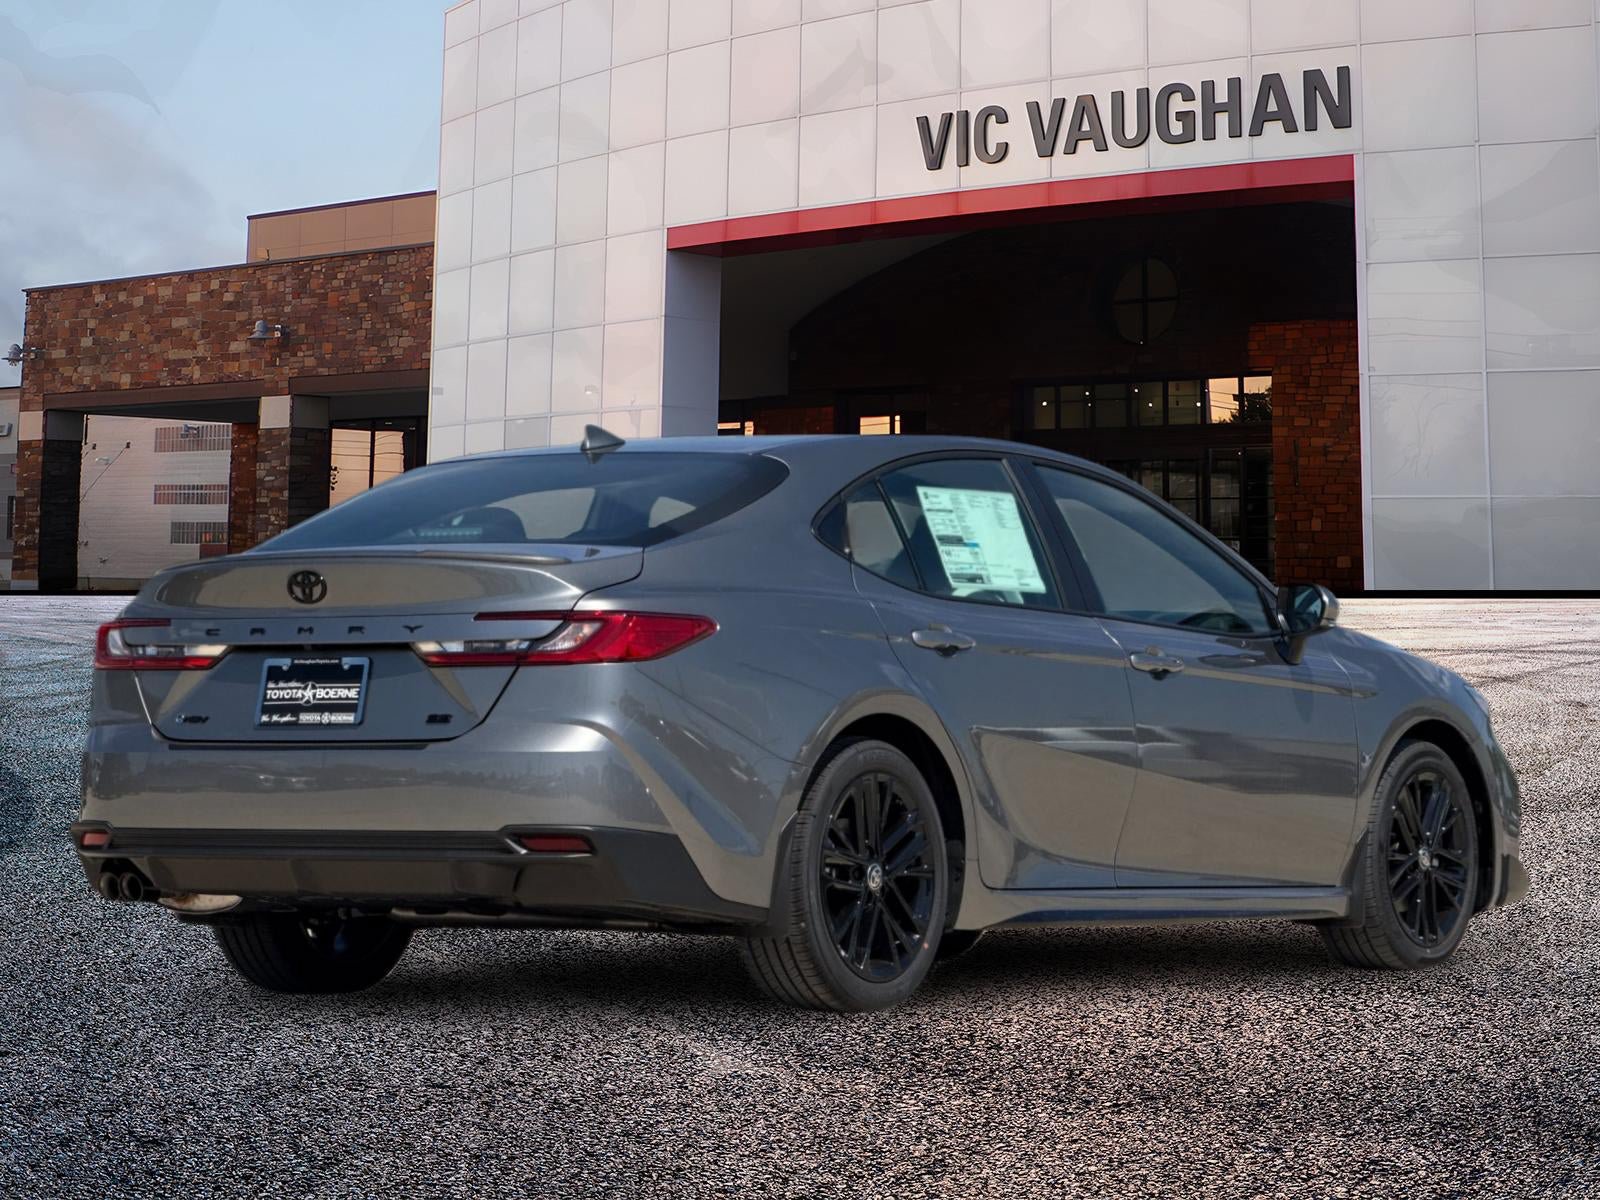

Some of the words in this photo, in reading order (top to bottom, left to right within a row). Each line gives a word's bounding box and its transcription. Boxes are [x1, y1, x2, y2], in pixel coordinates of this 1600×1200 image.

[916, 105, 1009, 171] VIC
[1026, 65, 1352, 158] VAUGHAN
[205, 625, 423, 636] CAMRY
[266, 689, 303, 699] TOYOTA
[316, 689, 360, 698] BOERNE
